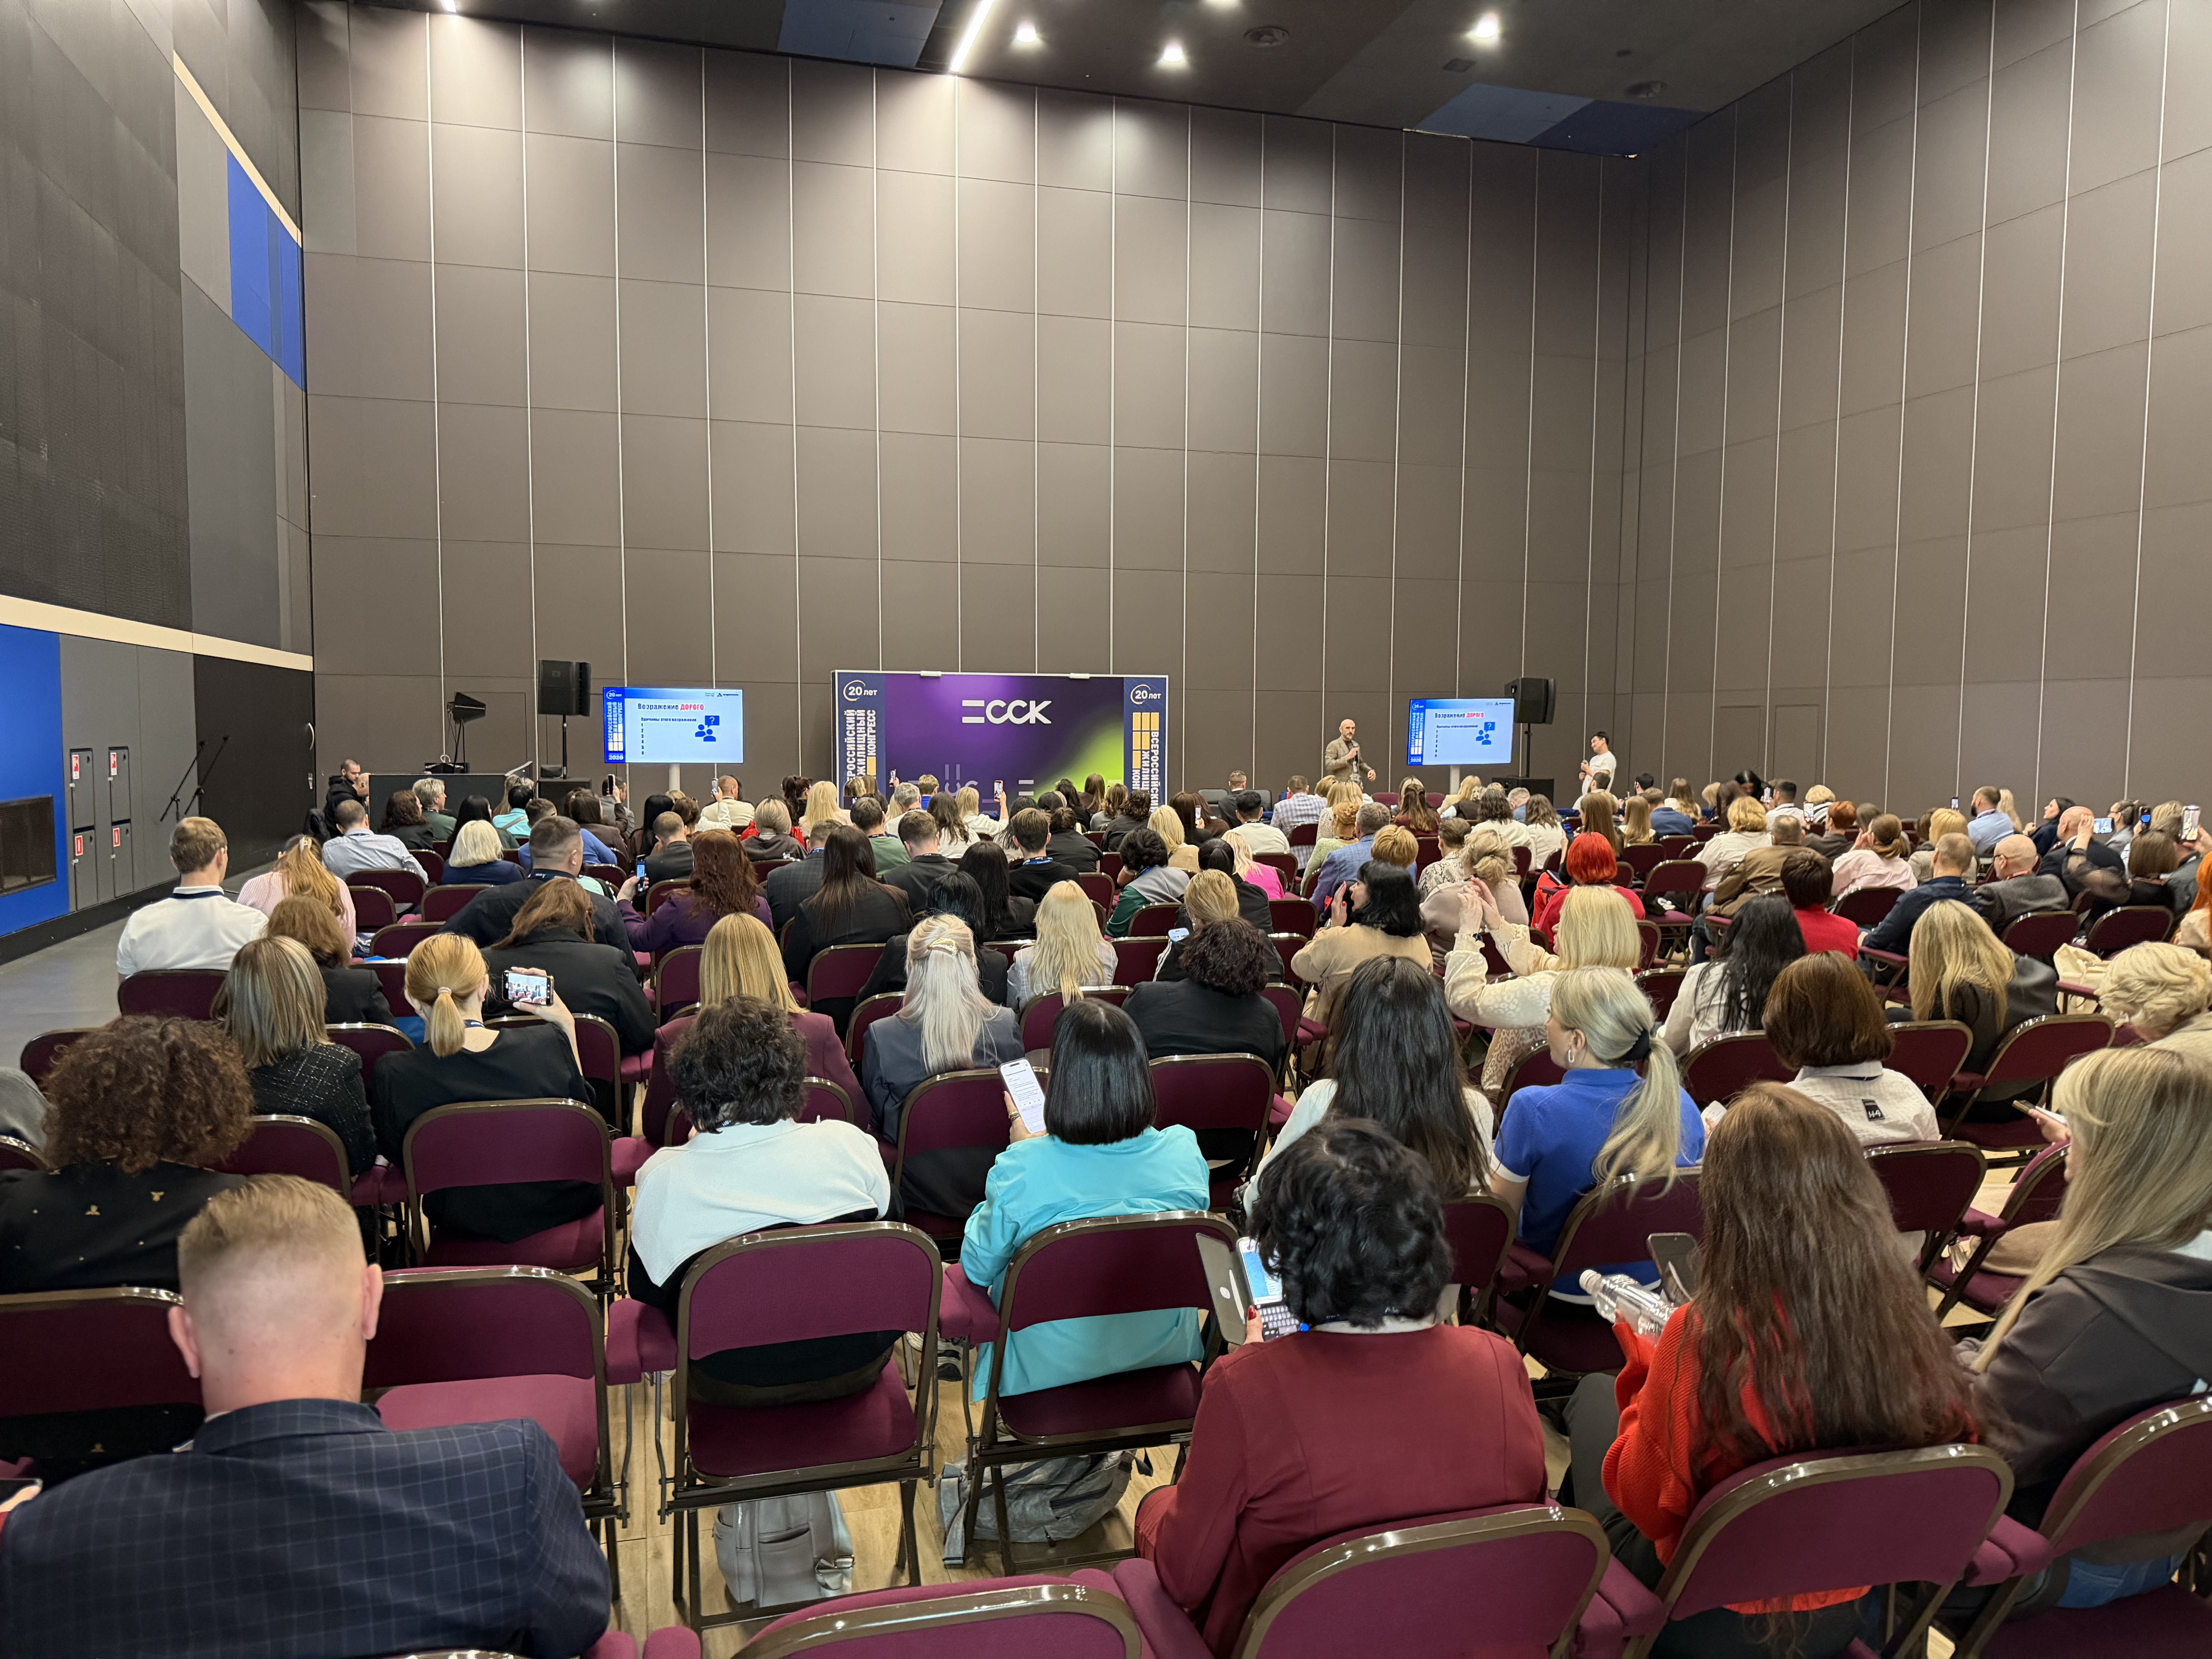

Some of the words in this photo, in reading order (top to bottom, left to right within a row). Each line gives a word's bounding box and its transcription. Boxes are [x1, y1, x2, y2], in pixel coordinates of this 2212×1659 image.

[848, 686, 862, 696] 20
[1135, 690, 1148, 699] 20
[844, 709, 855, 781] РОССИЙСКИЙ
[854, 709, 867, 776] ЖИЛИЩНЫЙ
[867, 709, 876, 756] КОНГРЕСС
[1132, 769, 1140, 790] КОНГ
[1140, 751, 1150, 790] ЖИЛИЩ
